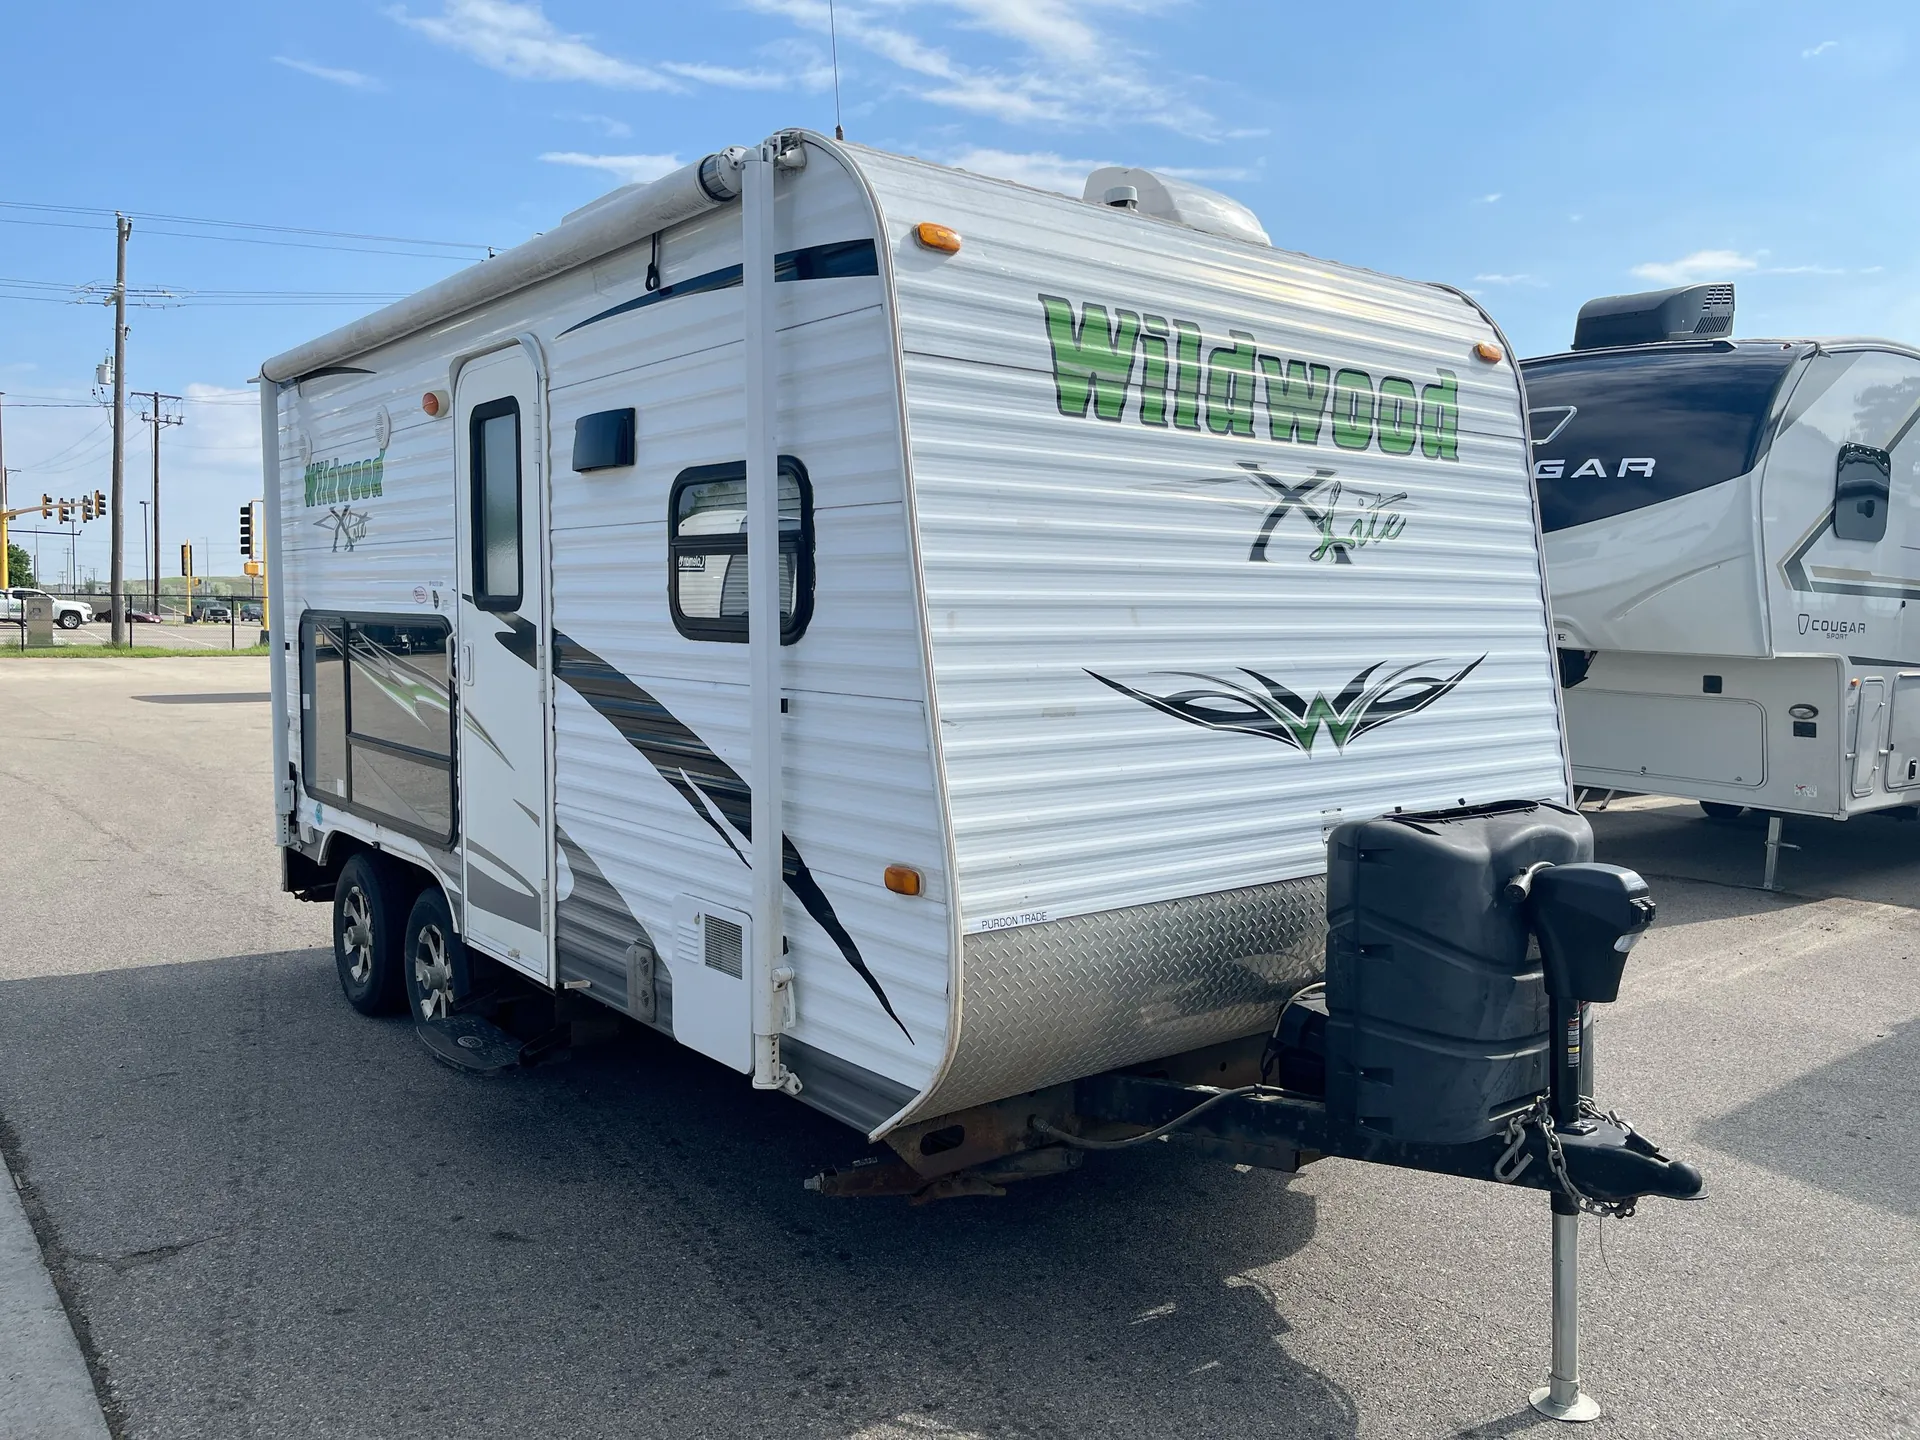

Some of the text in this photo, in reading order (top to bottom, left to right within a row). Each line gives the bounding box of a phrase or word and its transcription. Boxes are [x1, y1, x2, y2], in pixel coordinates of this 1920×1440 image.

[1038, 294, 1459, 462] Wildwood
[1534, 457, 1656, 478] GAR
[304, 449, 385, 507] Wildwood
[1812, 619, 1866, 634] COUGAR
[1826, 632, 1848, 640] SPORT
[981, 911, 1047, 930] PURDON TRADE
